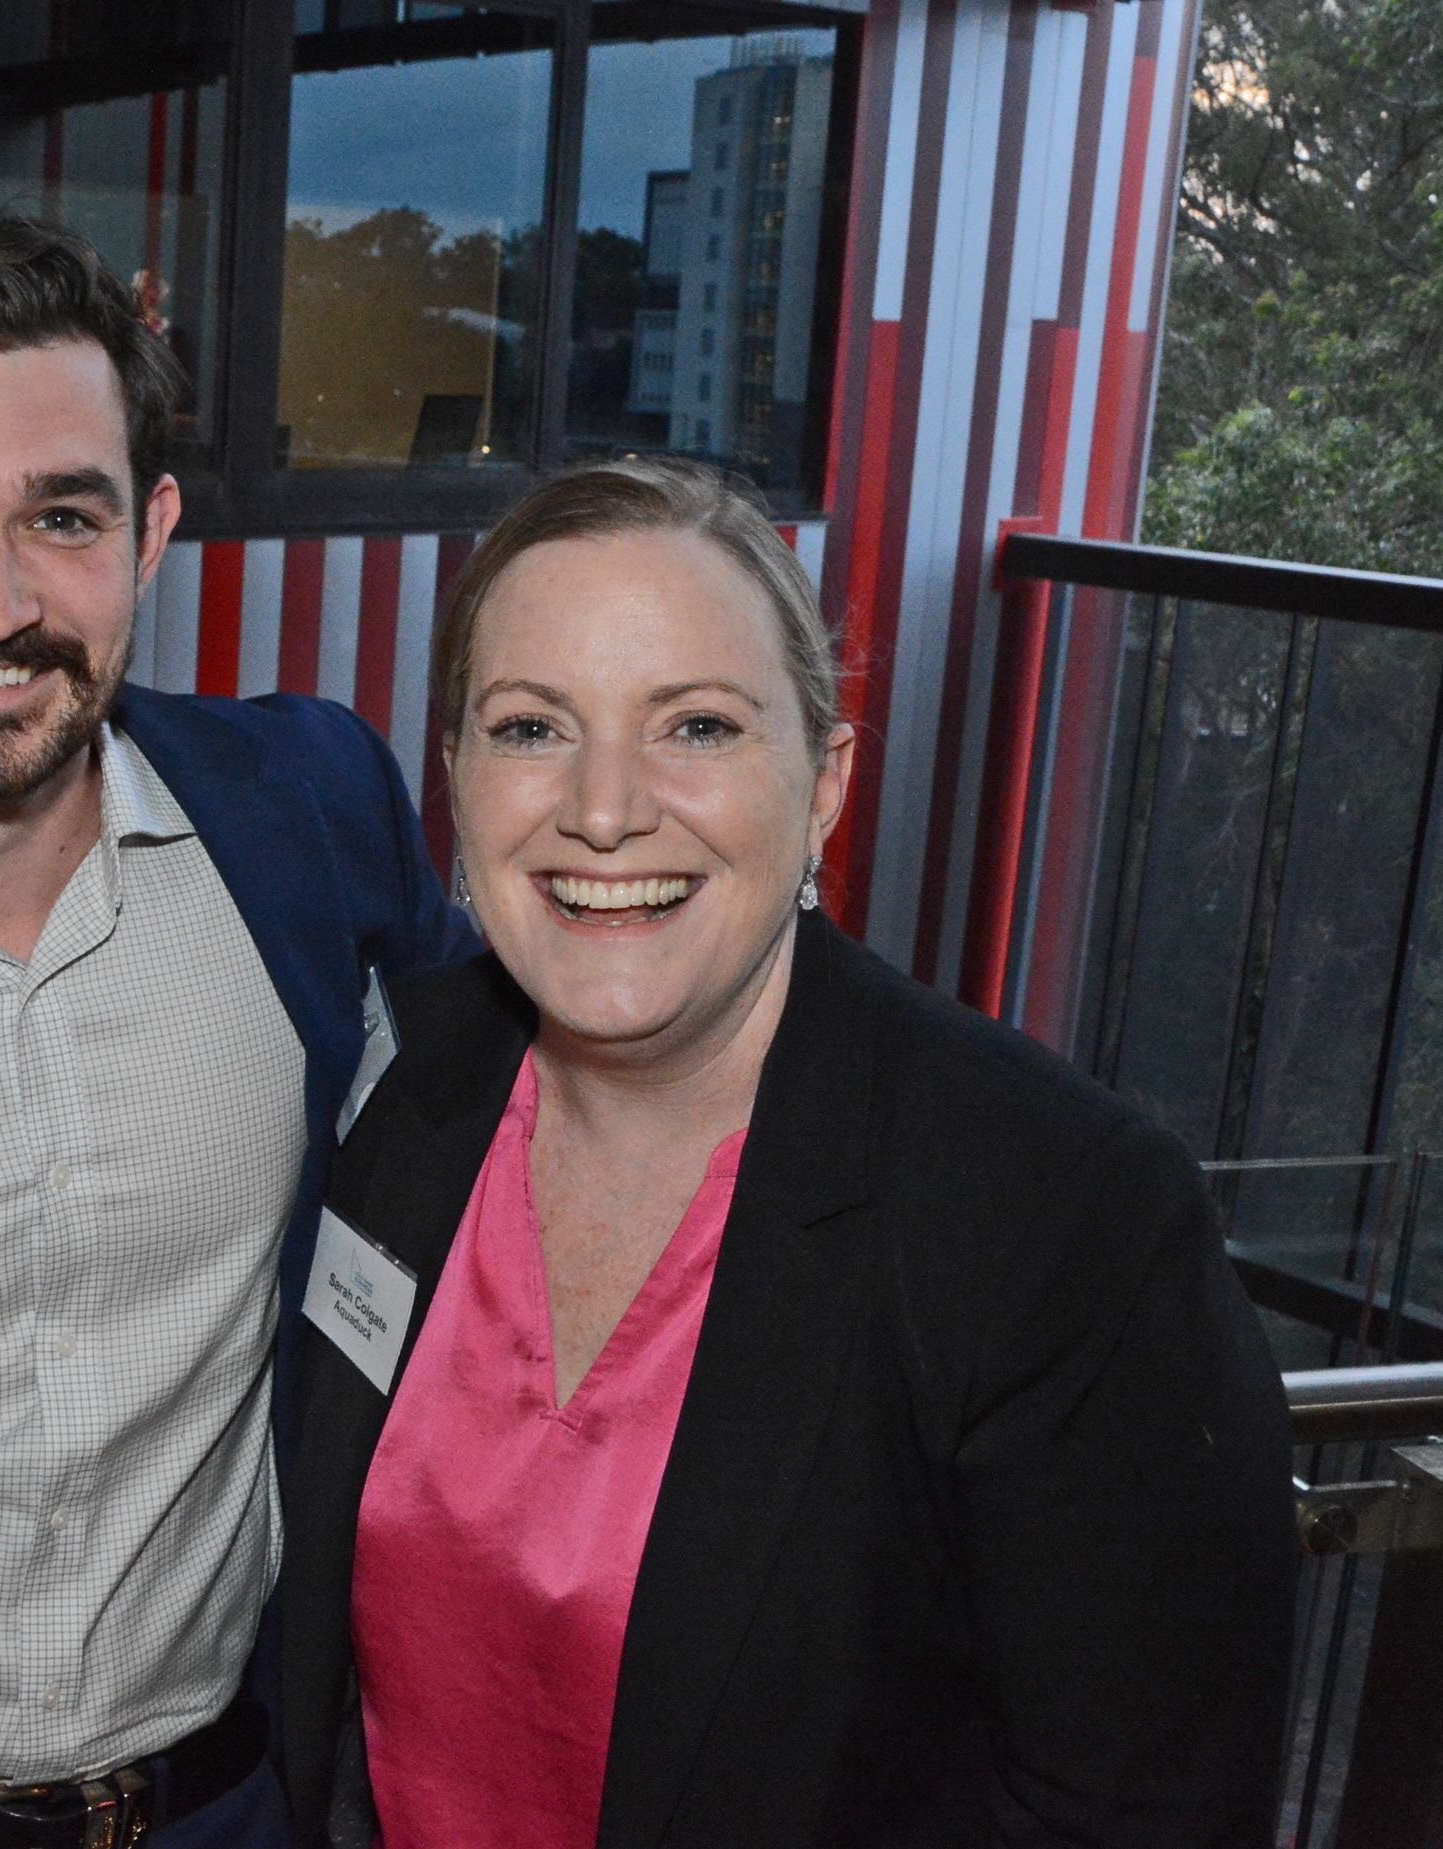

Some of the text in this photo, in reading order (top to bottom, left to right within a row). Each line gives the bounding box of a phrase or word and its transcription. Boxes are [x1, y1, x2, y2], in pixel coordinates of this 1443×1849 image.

[329, 1272, 353, 1303] Sarah
[355, 1296, 387, 1333] Colgate
[334, 1299, 372, 1342] Aquaduck
